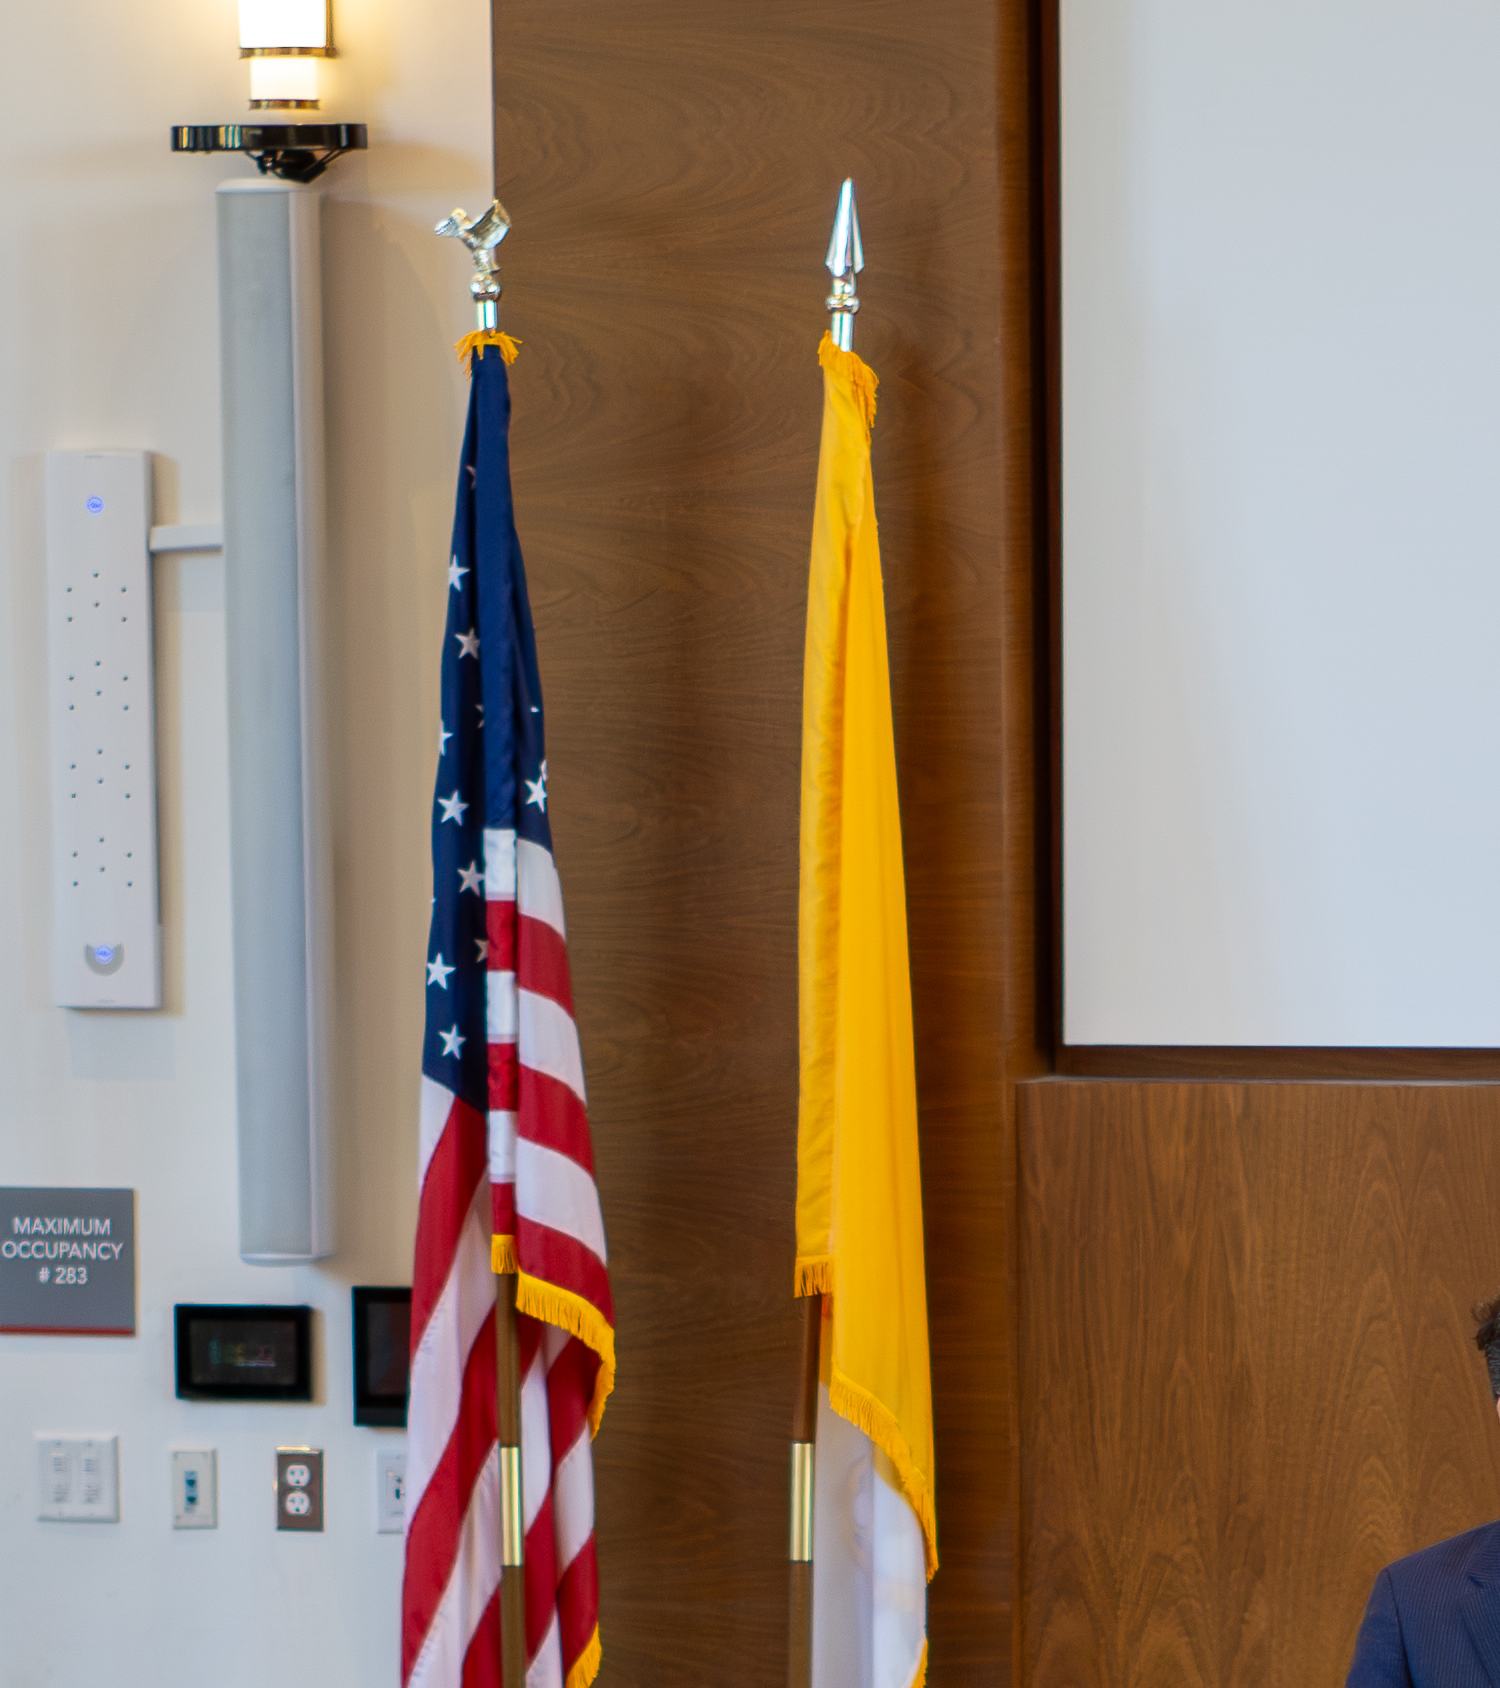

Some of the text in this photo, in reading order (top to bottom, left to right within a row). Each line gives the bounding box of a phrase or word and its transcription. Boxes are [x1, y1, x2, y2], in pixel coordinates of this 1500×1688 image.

[12, 1216, 112, 1236] MAXIMUM
[1, 1240, 124, 1261] OCCUPANCY
[38, 1266, 89, 1285] # 283
